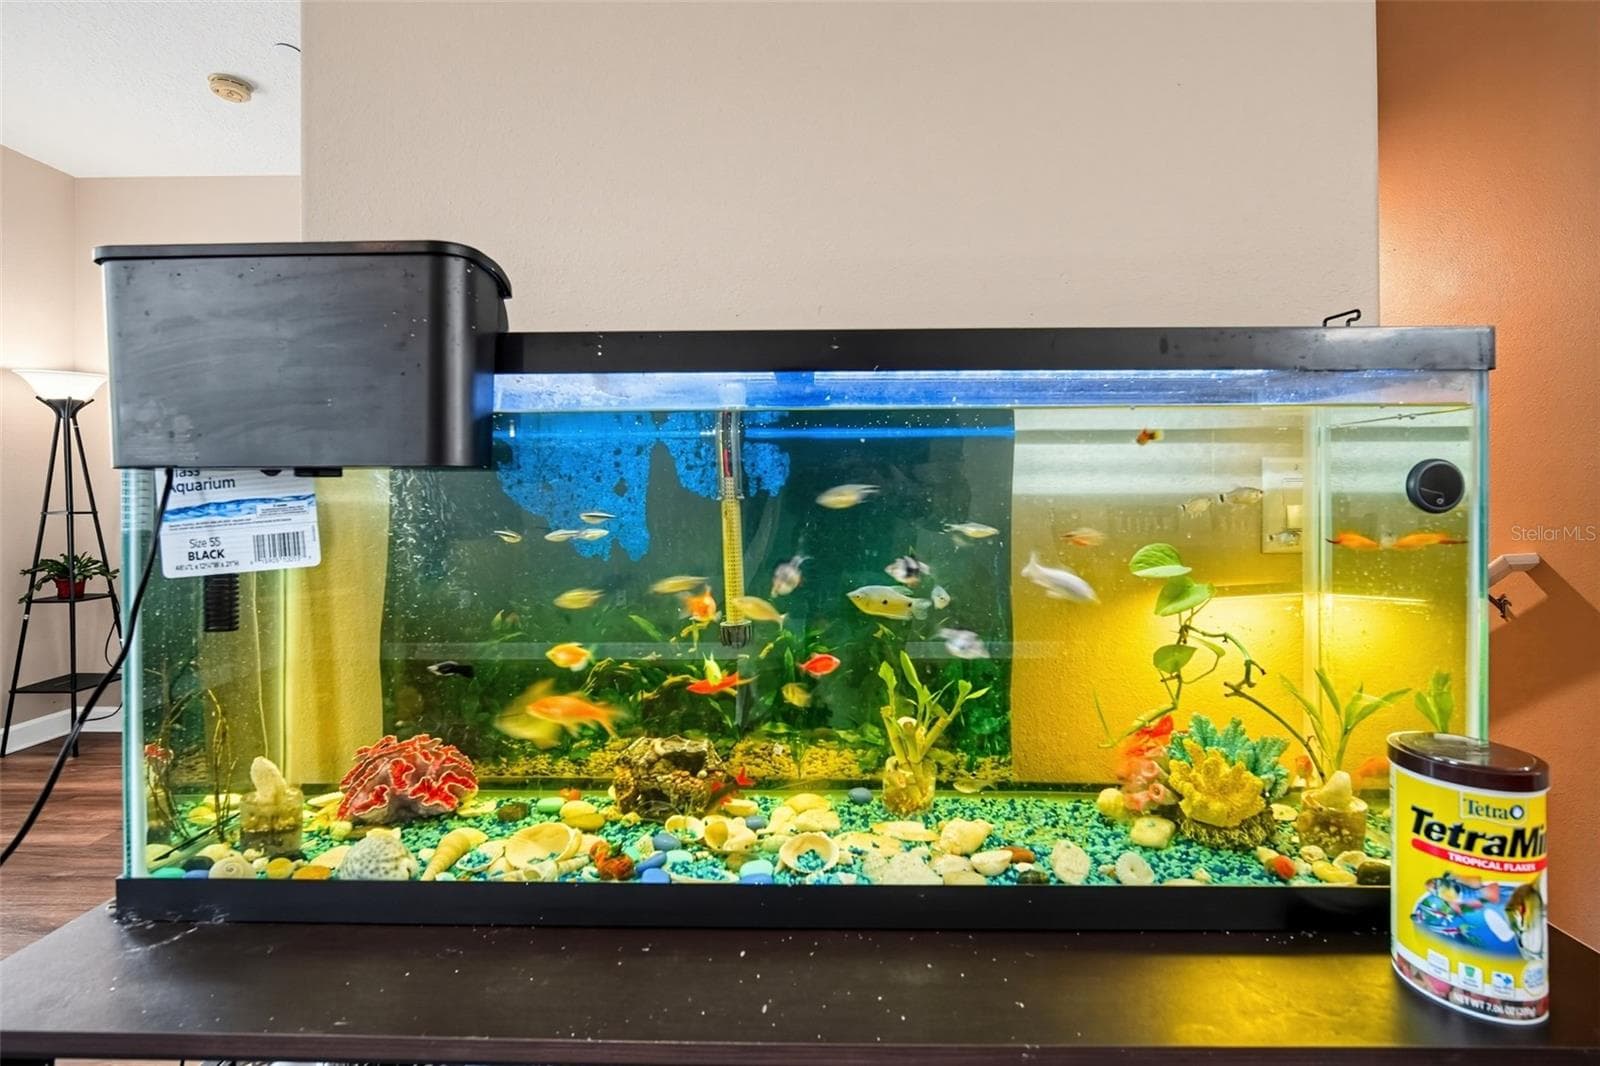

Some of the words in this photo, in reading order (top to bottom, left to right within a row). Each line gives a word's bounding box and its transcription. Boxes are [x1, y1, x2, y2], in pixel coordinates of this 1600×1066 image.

[189, 538, 207, 549] Size
[188, 549, 225, 561] BLACK
[1464, 799, 1508, 820] Tetra
[1411, 804, 1546, 859] TetraMi
[1448, 852, 1502, 872] TROPICAL
[1503, 863, 1537, 872] FLAKES
